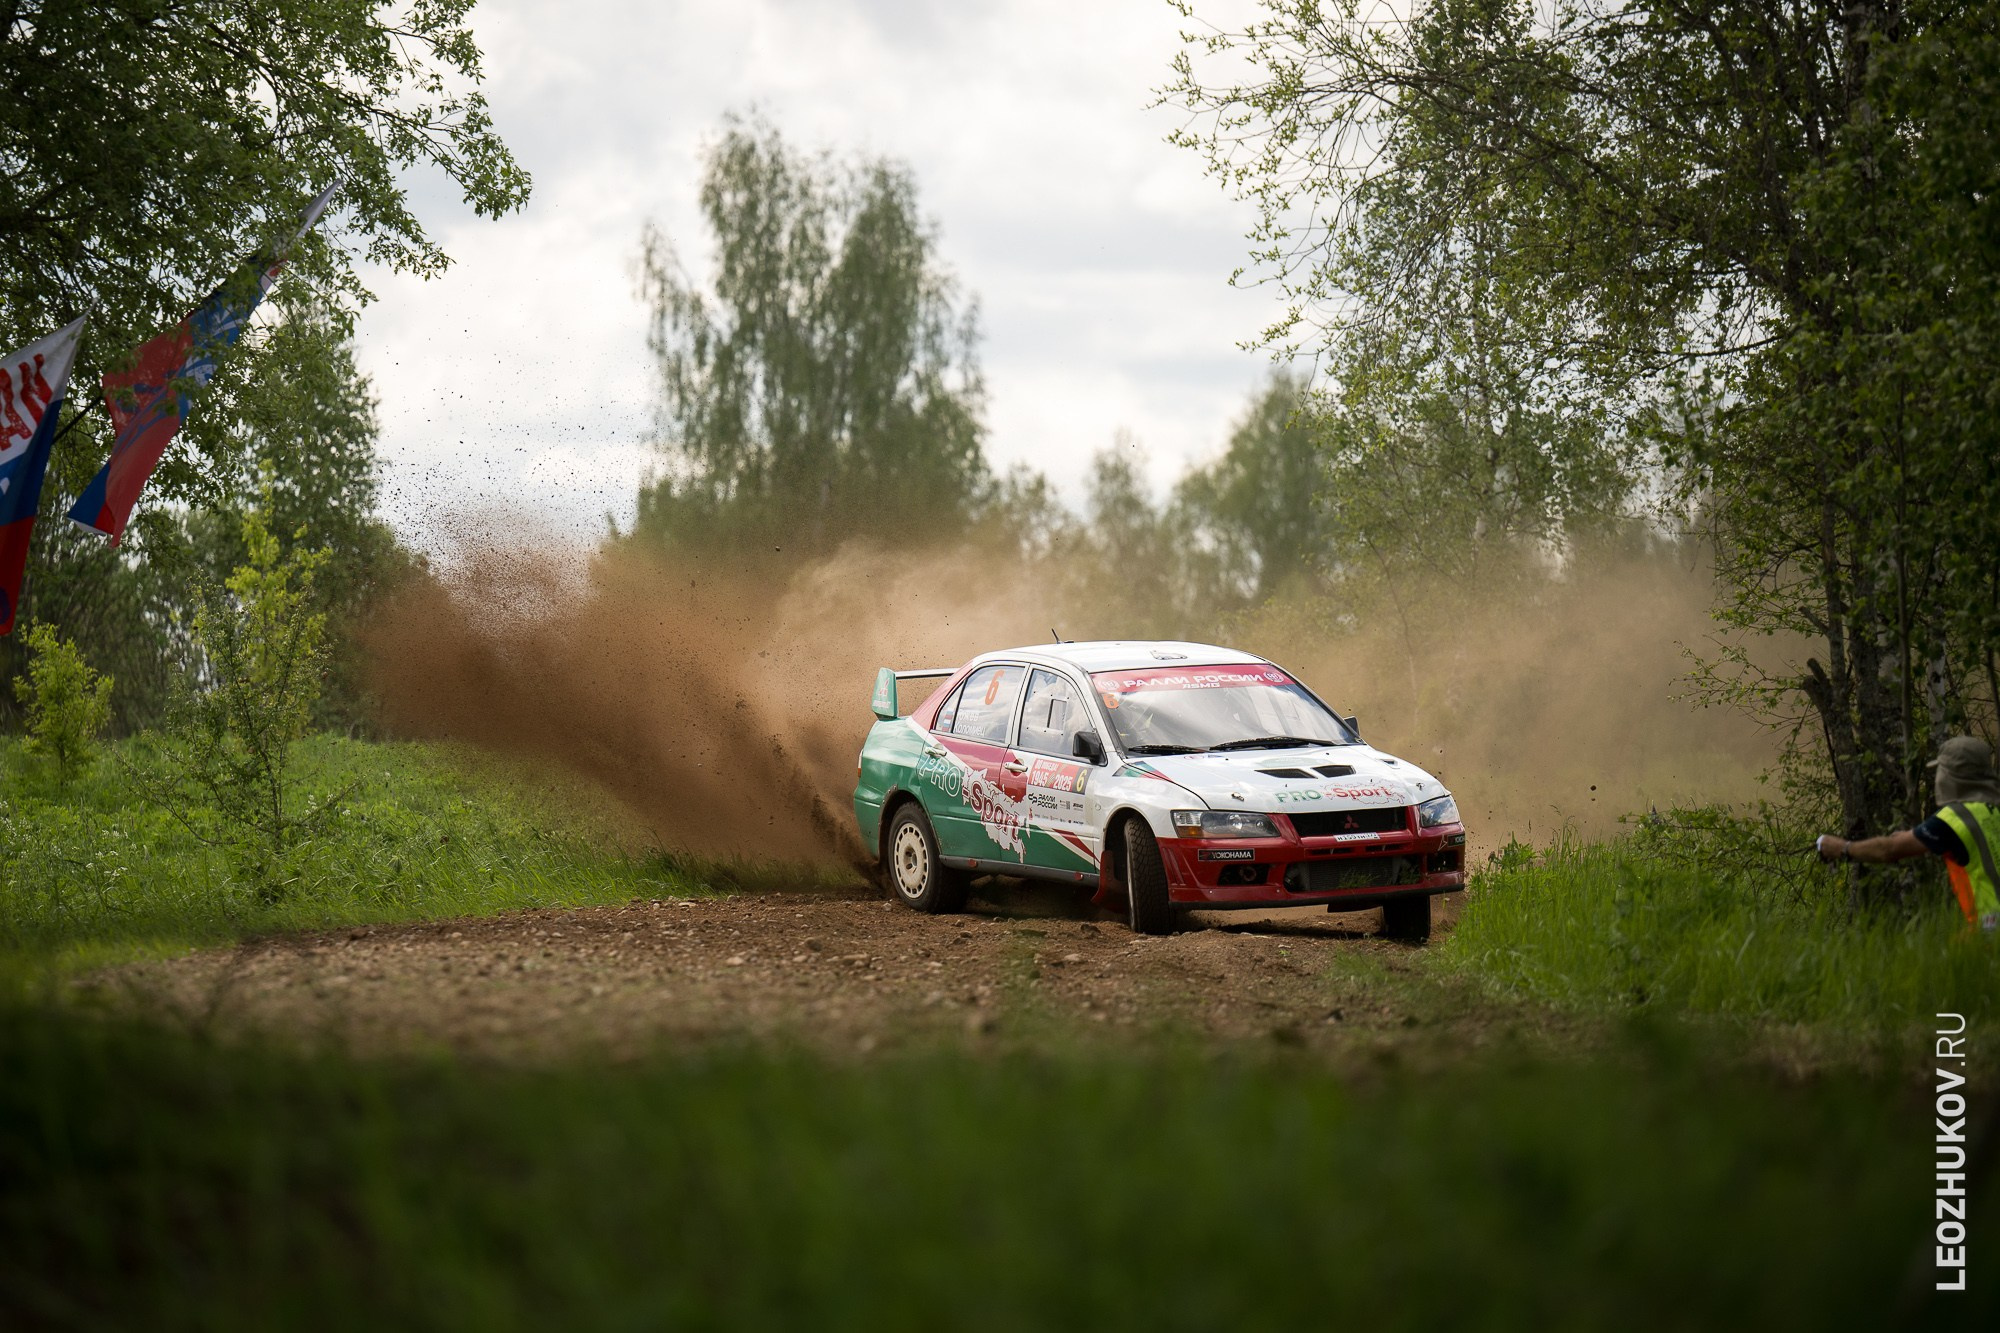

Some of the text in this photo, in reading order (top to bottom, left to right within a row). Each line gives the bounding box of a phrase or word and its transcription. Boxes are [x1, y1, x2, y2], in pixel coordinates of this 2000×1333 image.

[985, 669, 1005, 706] 6
[1123, 674, 1264, 688] РАЛЛИ РОССИИ
[1103, 693, 1119, 709] 6
[1031, 770, 1073, 792] 1945 2025
[1077, 769, 1088, 792] 6
[1211, 851, 1252, 859] YOKOHAMA
